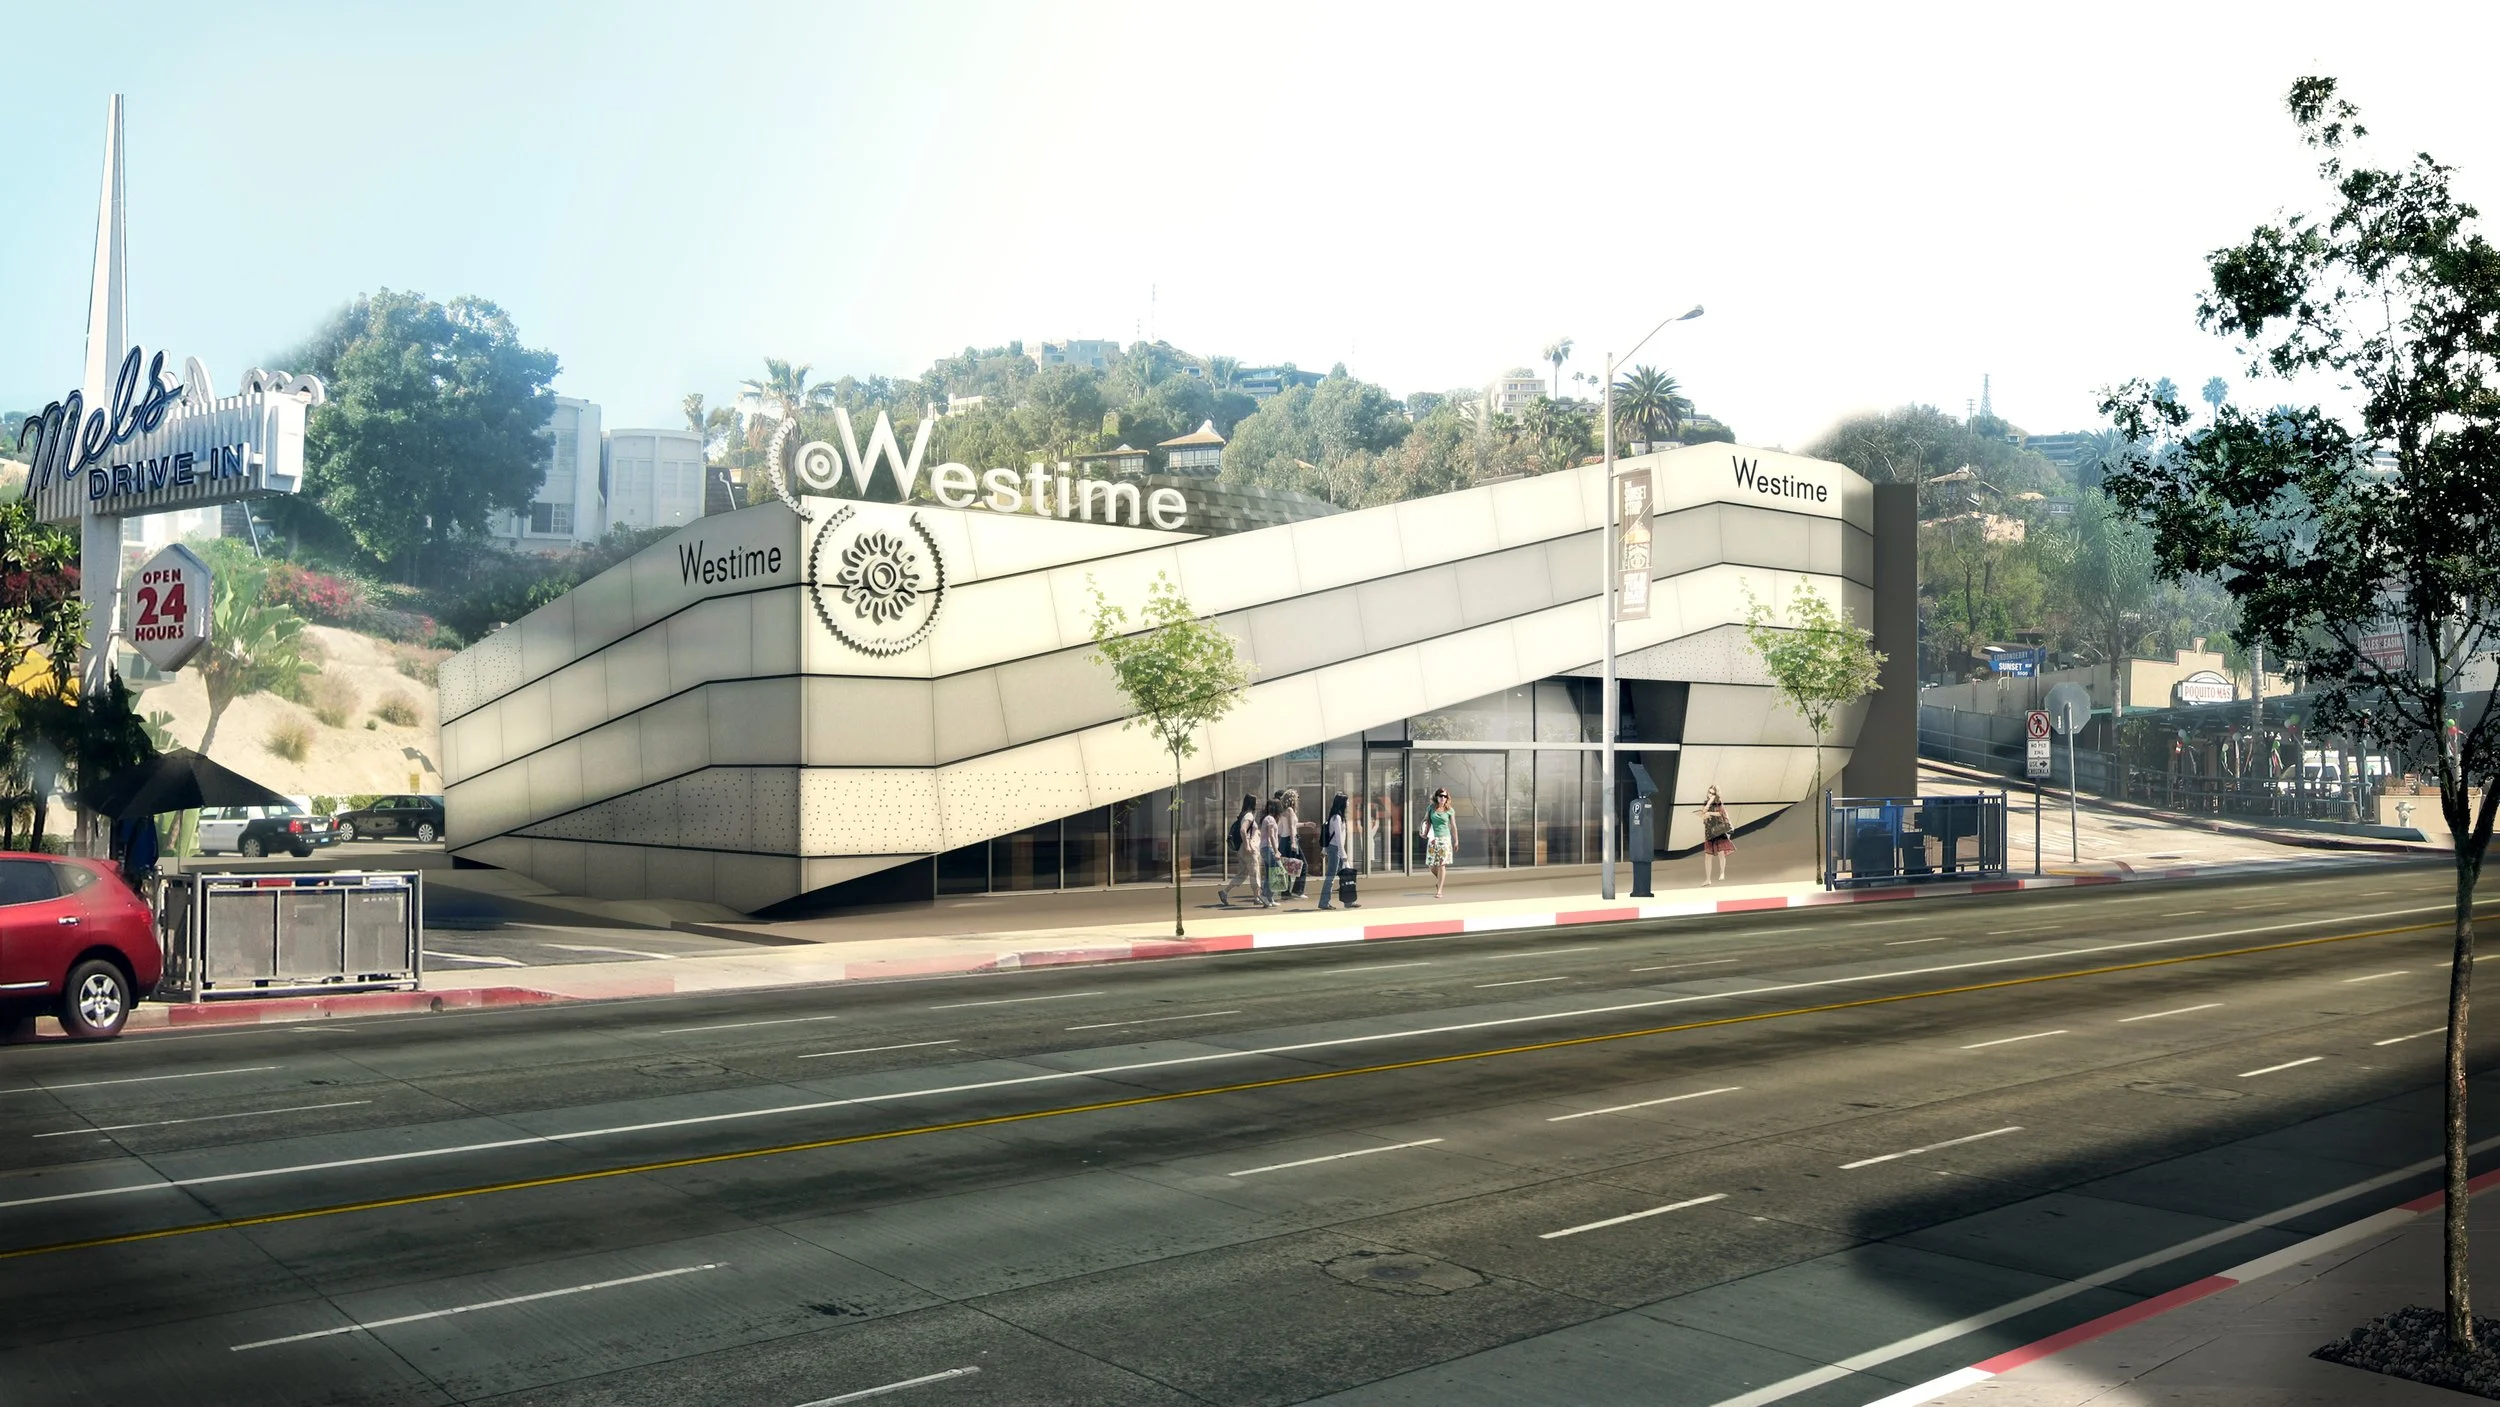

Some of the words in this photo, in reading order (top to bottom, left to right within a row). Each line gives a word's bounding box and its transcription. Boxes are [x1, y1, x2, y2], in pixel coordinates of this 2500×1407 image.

[89, 451, 196, 501] DRIVE
[211, 444, 247, 480] IN
[833, 407, 1187, 530] Westime
[1732, 455, 1827, 502] Westime
[143, 568, 182, 585] OPEN
[679, 540, 781, 587] Westime
[136, 583, 187, 626] 24
[135, 625, 184, 641] HOURS
[1999, 662, 2022, 671] SUNSET
[2185, 686, 2216, 699] POQUITO
